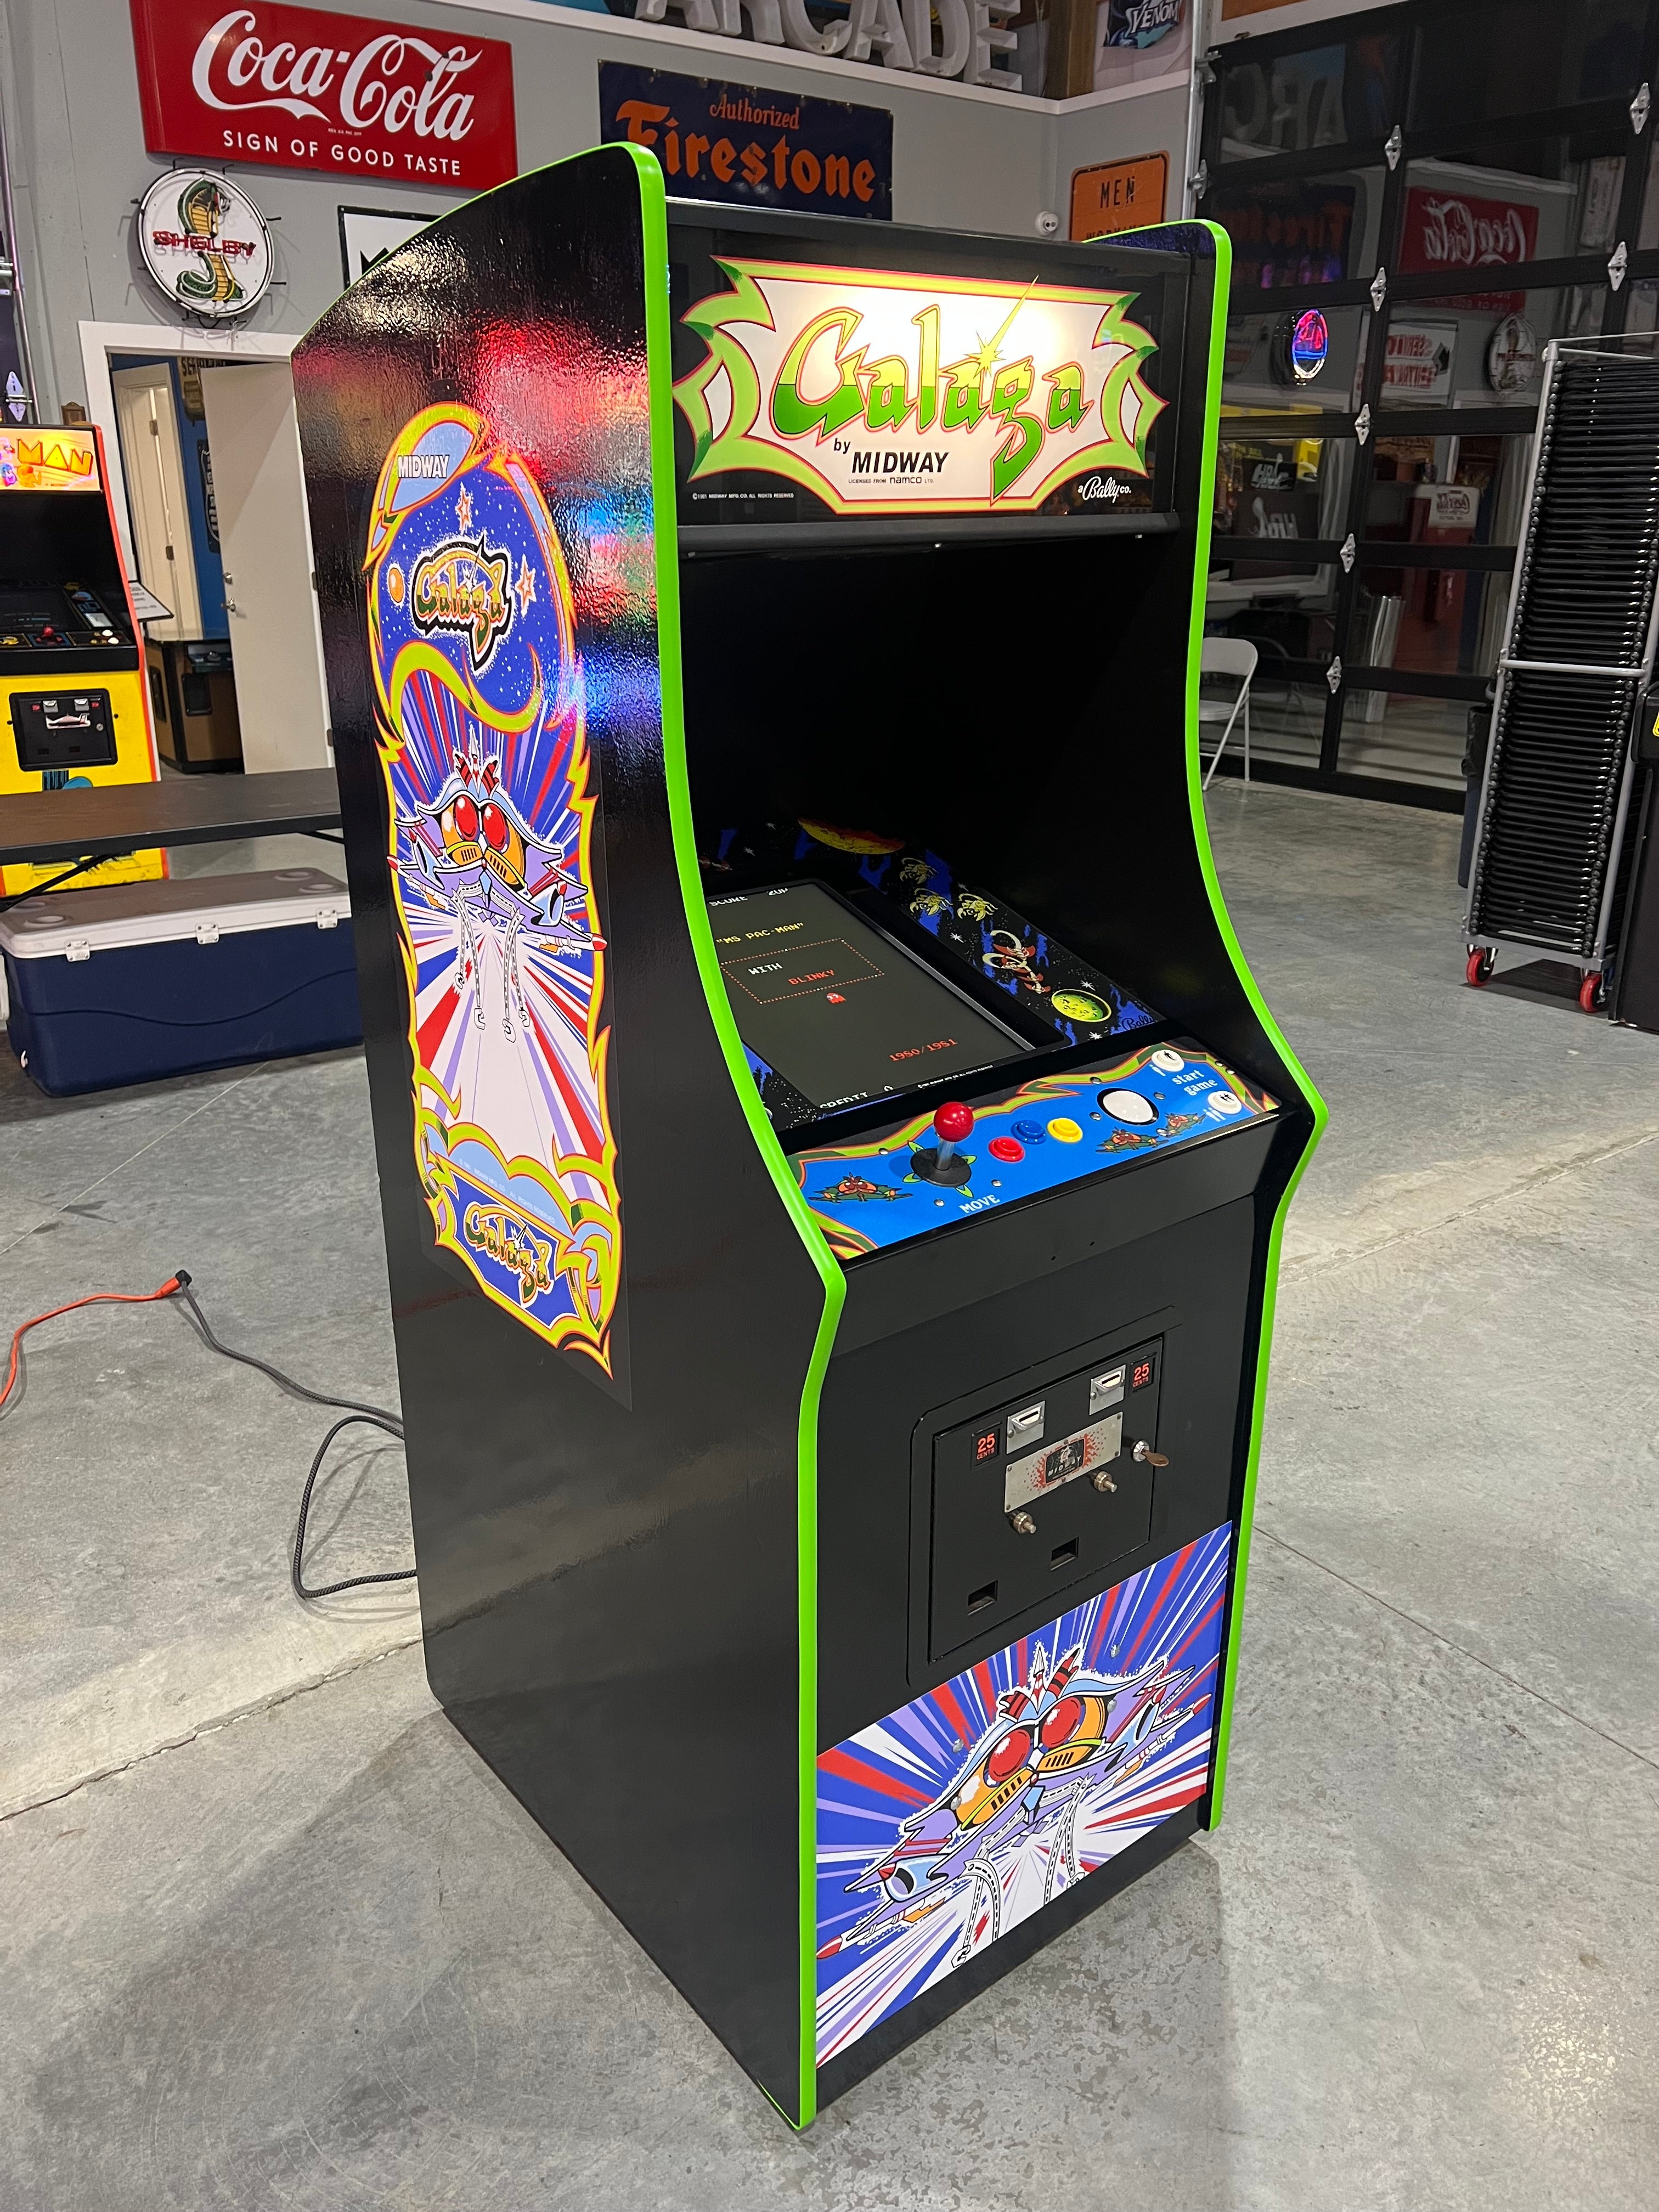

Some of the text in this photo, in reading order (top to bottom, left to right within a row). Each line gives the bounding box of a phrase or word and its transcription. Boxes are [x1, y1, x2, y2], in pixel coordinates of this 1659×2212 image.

[1131, 1, 1178, 33] VENOM
[192, 9, 483, 141] Coca-Cola
[710, 94, 800, 129] Authorized
[224, 130, 461, 176] SIGN OF GOOD TASTE
[616, 99, 876, 202] Firestone
[1100, 176, 1136, 208] MEN
[153, 231, 256, 256] SHELBY
[769, 304, 1094, 506] Galaga
[18, 438, 93, 476] MAN
[398, 455, 450, 478] MIDWAY
[834, 438, 950, 473] by MIDWAY
[1082, 476, 1120, 504] Bally
[1120, 486, 1132, 494] co.
[415, 550, 505, 654] Galaga
[748, 963, 783, 975] WITH
[788, 969, 834, 985] BLINKY
[889, 1039, 958, 1062] 1980/1981
[1172, 1069, 1205, 1085] start
[1183, 1079, 1218, 1096] game
[958, 1194, 1000, 1214] MOVE
[465, 1204, 551, 1304] Galaga
[1132, 1376, 1149, 1388] CENTS
[1133, 1363, 1150, 1381] 25
[977, 1447, 995, 1460] CENTS
[978, 1433, 995, 1453] 25
